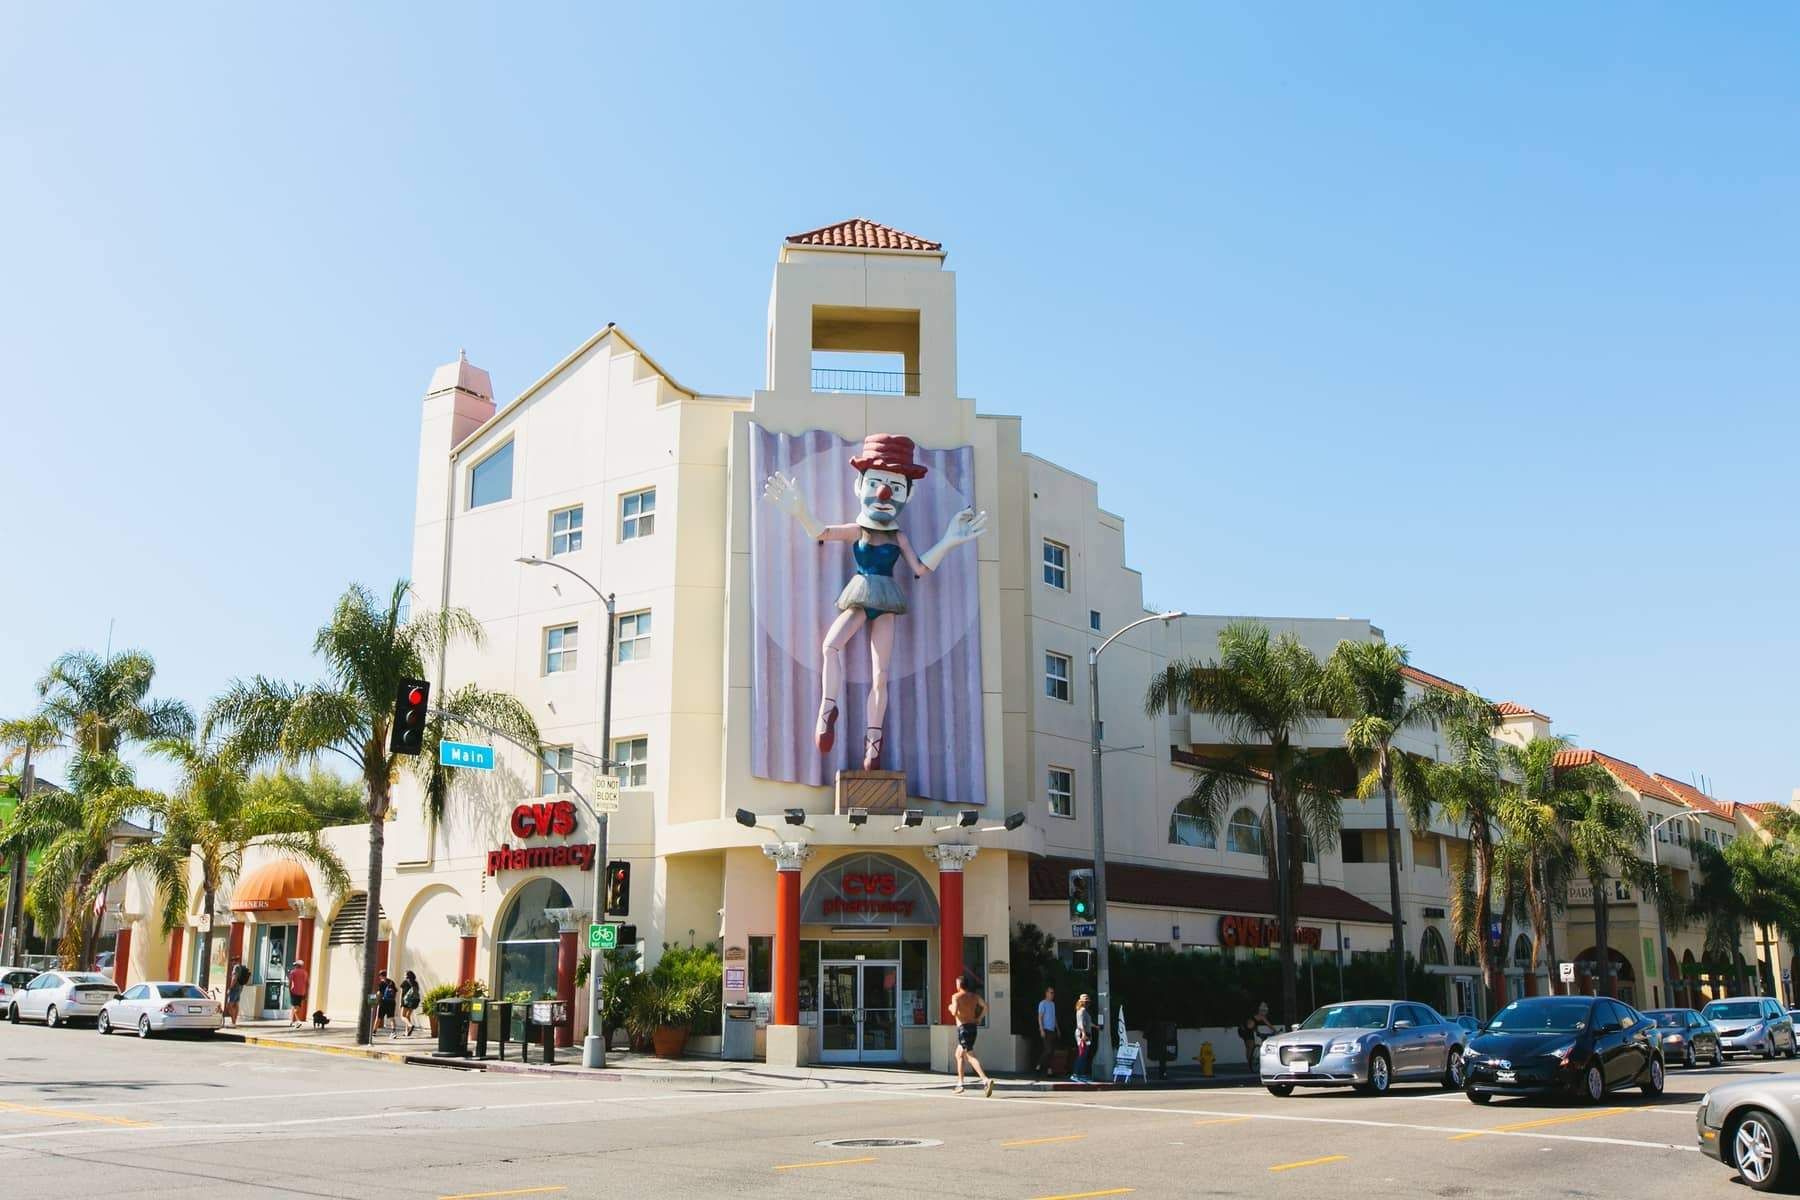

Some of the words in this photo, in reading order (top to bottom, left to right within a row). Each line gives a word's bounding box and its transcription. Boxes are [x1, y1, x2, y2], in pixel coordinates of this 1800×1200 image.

[451, 747, 484, 763] Main
[597, 780, 606, 788] DO
[607, 780, 618, 789] NOT
[597, 791, 618, 801] BLOCK
[511, 800, 578, 839] CVS
[487, 843, 596, 877] pharmacy
[843, 872, 897, 896] CVS
[1569, 887, 1613, 898] PARKG
[822, 895, 915, 917] pharmacy
[1219, 915, 1260, 947] CVS
